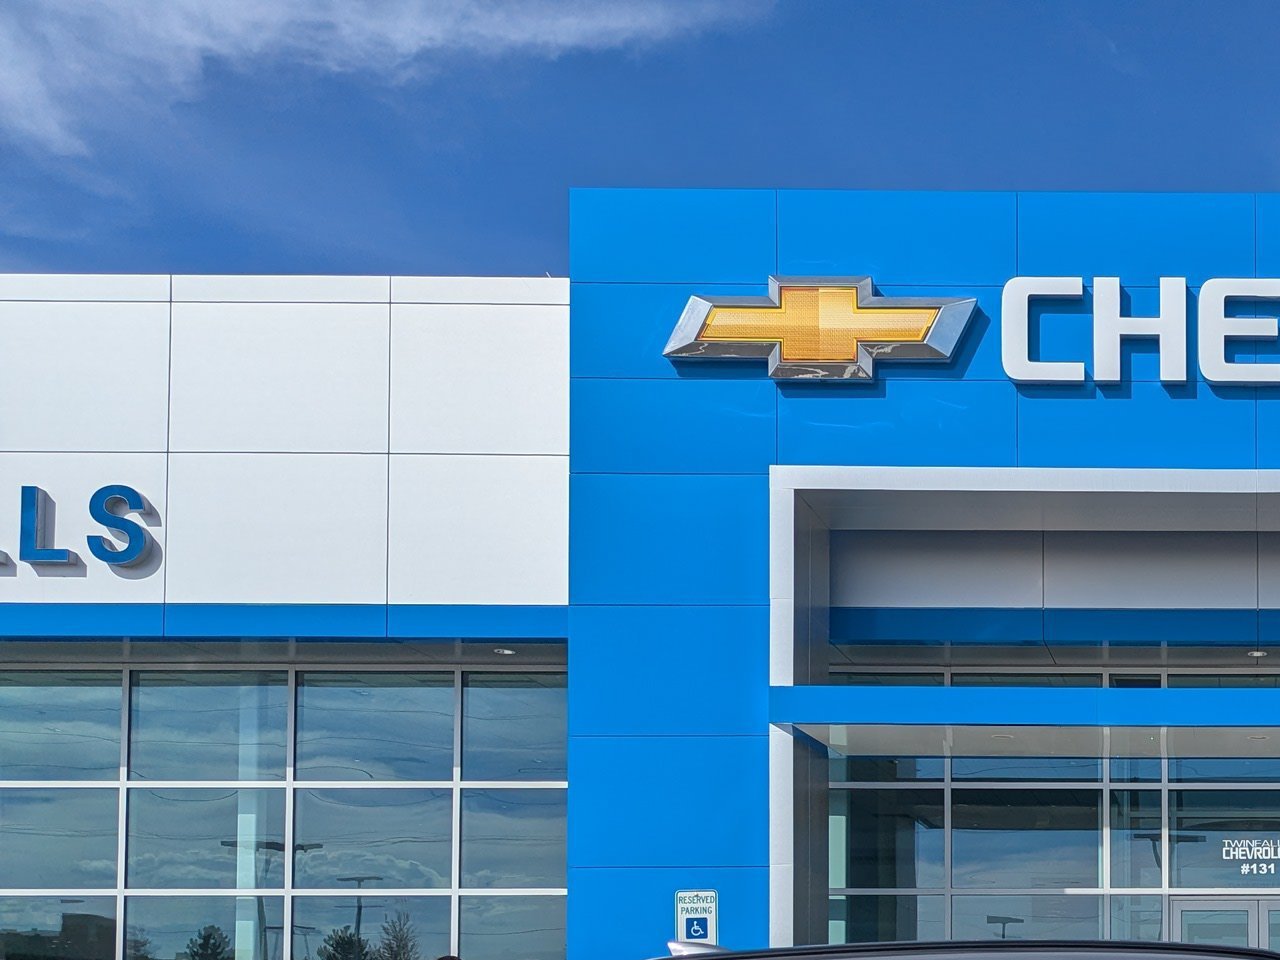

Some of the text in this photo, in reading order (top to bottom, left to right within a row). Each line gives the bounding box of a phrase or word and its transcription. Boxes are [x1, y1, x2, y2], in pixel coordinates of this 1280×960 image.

[0, 484, 148, 567] LS
[1241, 863, 1275, 875] #131
[678, 895, 715, 904] RESERVED
[680, 905, 713, 915] PARKING
